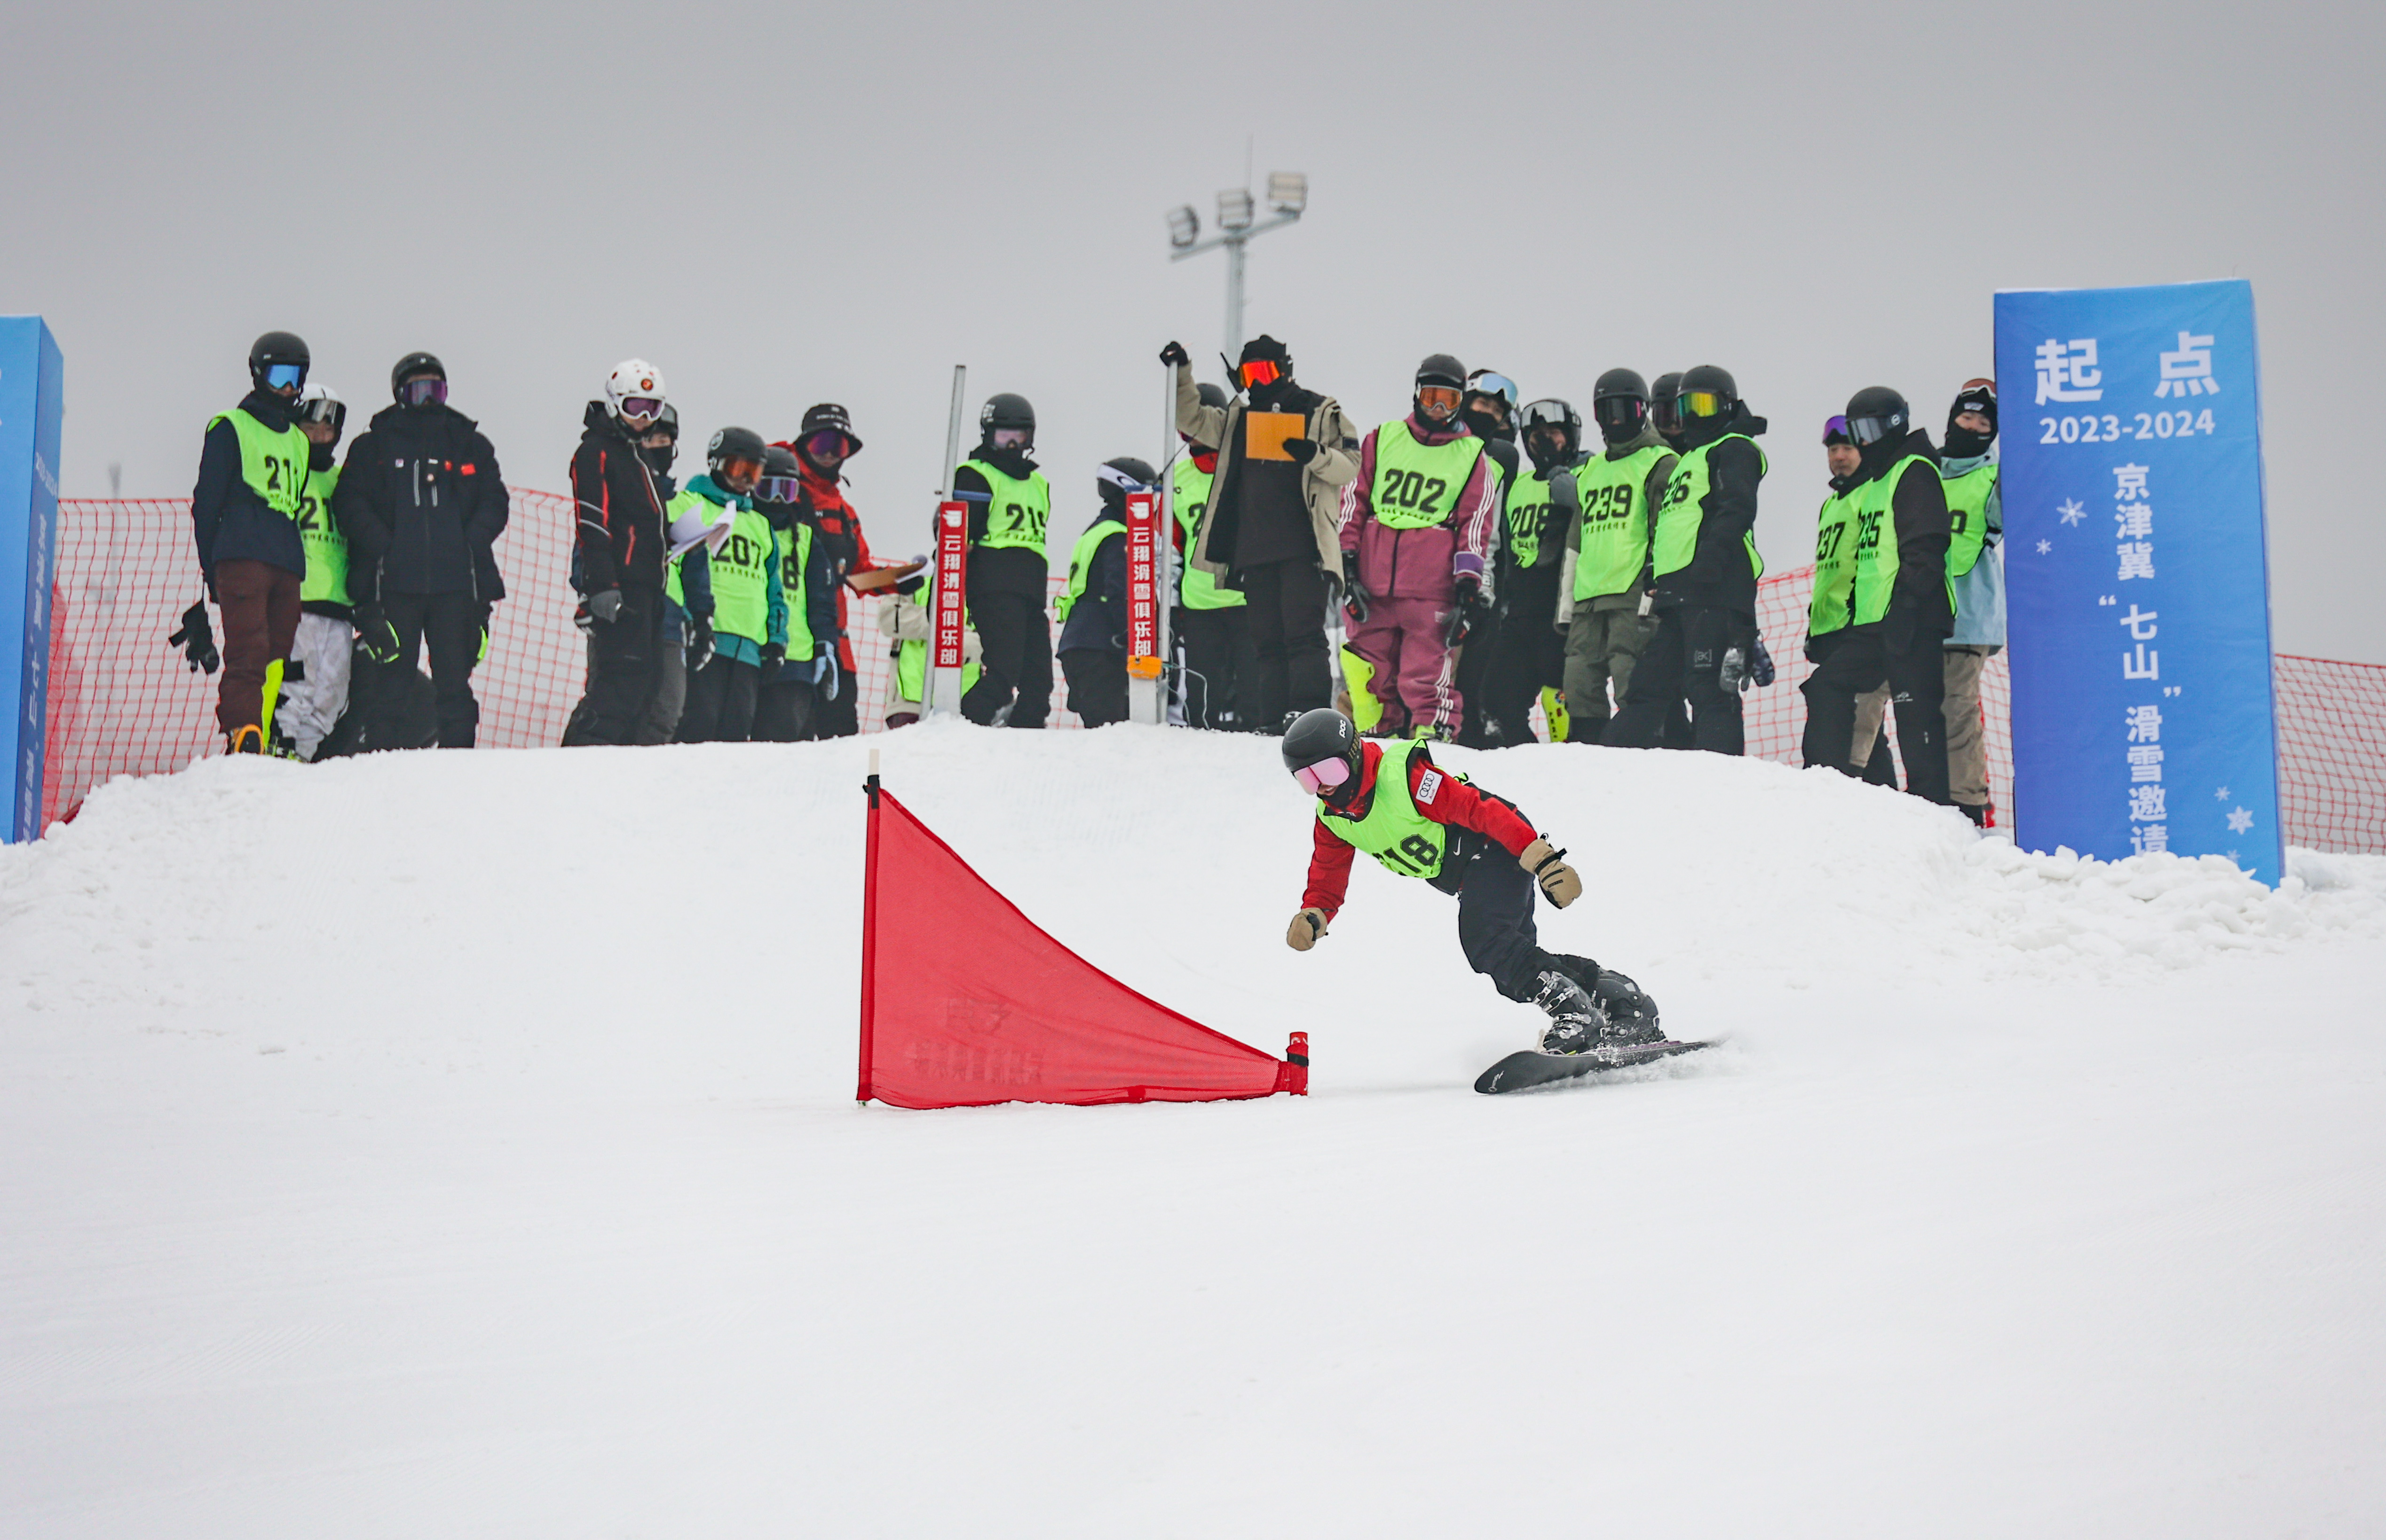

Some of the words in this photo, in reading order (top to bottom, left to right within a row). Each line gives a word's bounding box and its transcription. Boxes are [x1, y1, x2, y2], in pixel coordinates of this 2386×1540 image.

[2034, 331, 2220, 406] 起点
[2038, 408, 2216, 444] 2023-2024
[1381, 468, 1446, 513] 202
[1583, 484, 1633, 525] 239
[300, 497, 333, 532] 21
[940, 535, 962, 665] 云翔滑雪俱乐部
[1132, 526, 1152, 656] 云翔滑雪俱乐部
